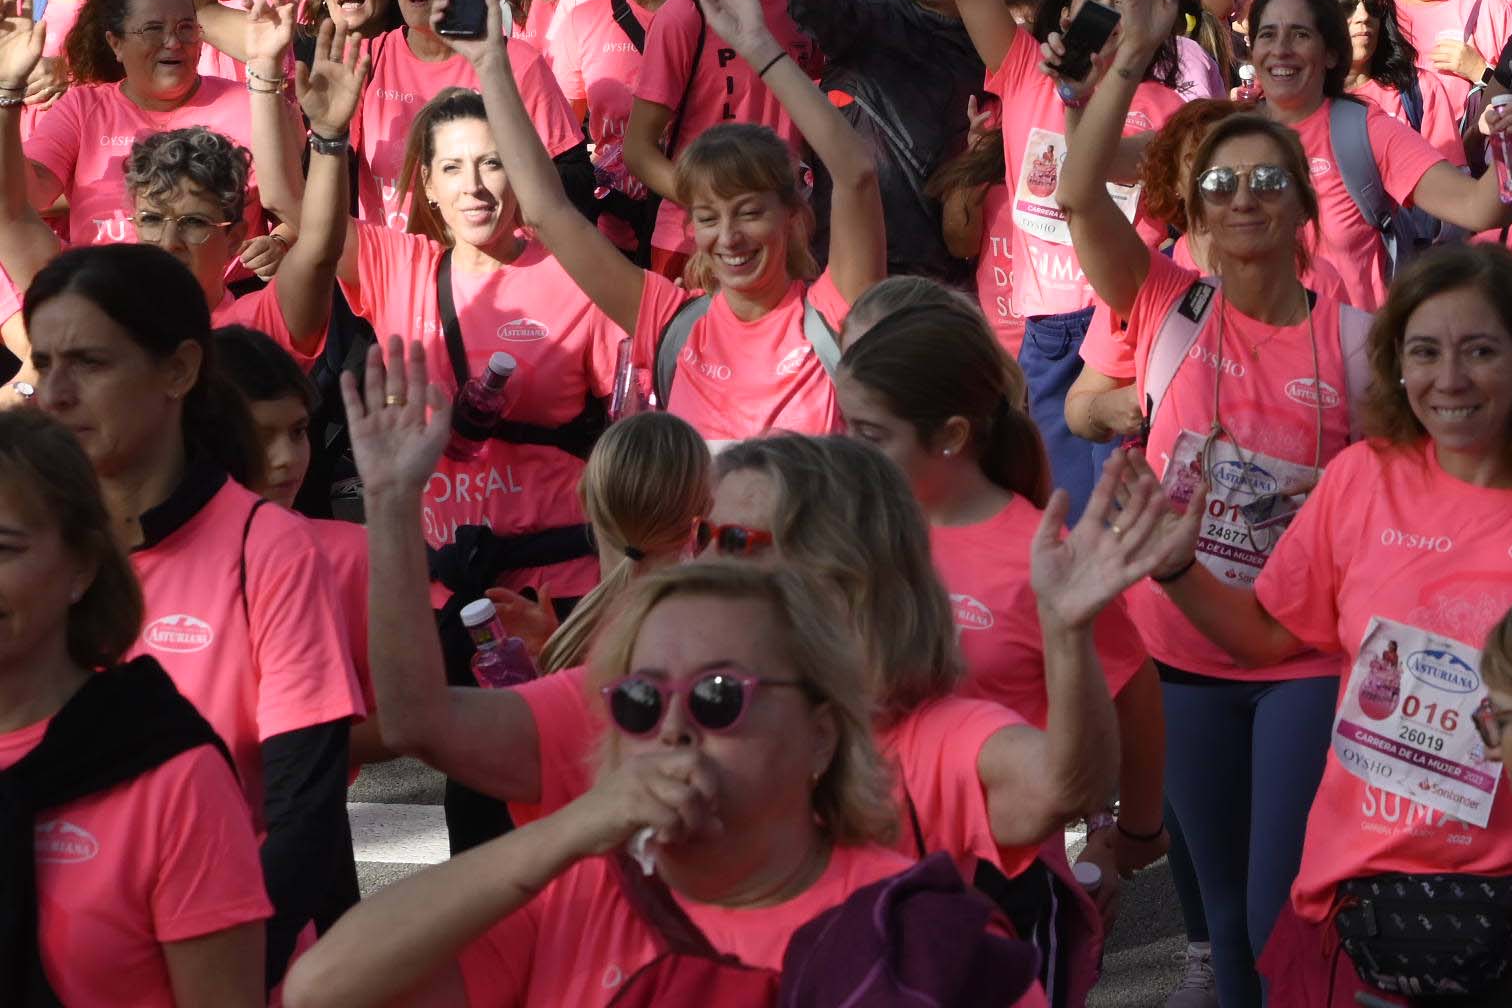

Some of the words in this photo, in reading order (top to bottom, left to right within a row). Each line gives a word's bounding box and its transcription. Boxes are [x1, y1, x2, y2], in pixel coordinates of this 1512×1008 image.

[1027, 204, 1060, 218] CARRERA
[424, 465, 523, 503] ORSAL
[1207, 523, 1248, 545] 24877
[1381, 527, 1452, 554] OYSHO
[1206, 542, 1219, 553] DE
[1220, 546, 1232, 557] LA
[1411, 656, 1472, 690] ASTURIANA
[1401, 695, 1460, 732] 016
[1354, 731, 1398, 756] CARRERA
[1398, 747, 1413, 760] DE
[1413, 751, 1426, 766] LA
[1428, 756, 1462, 776] MUJER
[1399, 725, 1444, 752] 26019
[1343, 747, 1393, 779] OYSHO
[1430, 782, 1480, 810] Santander
